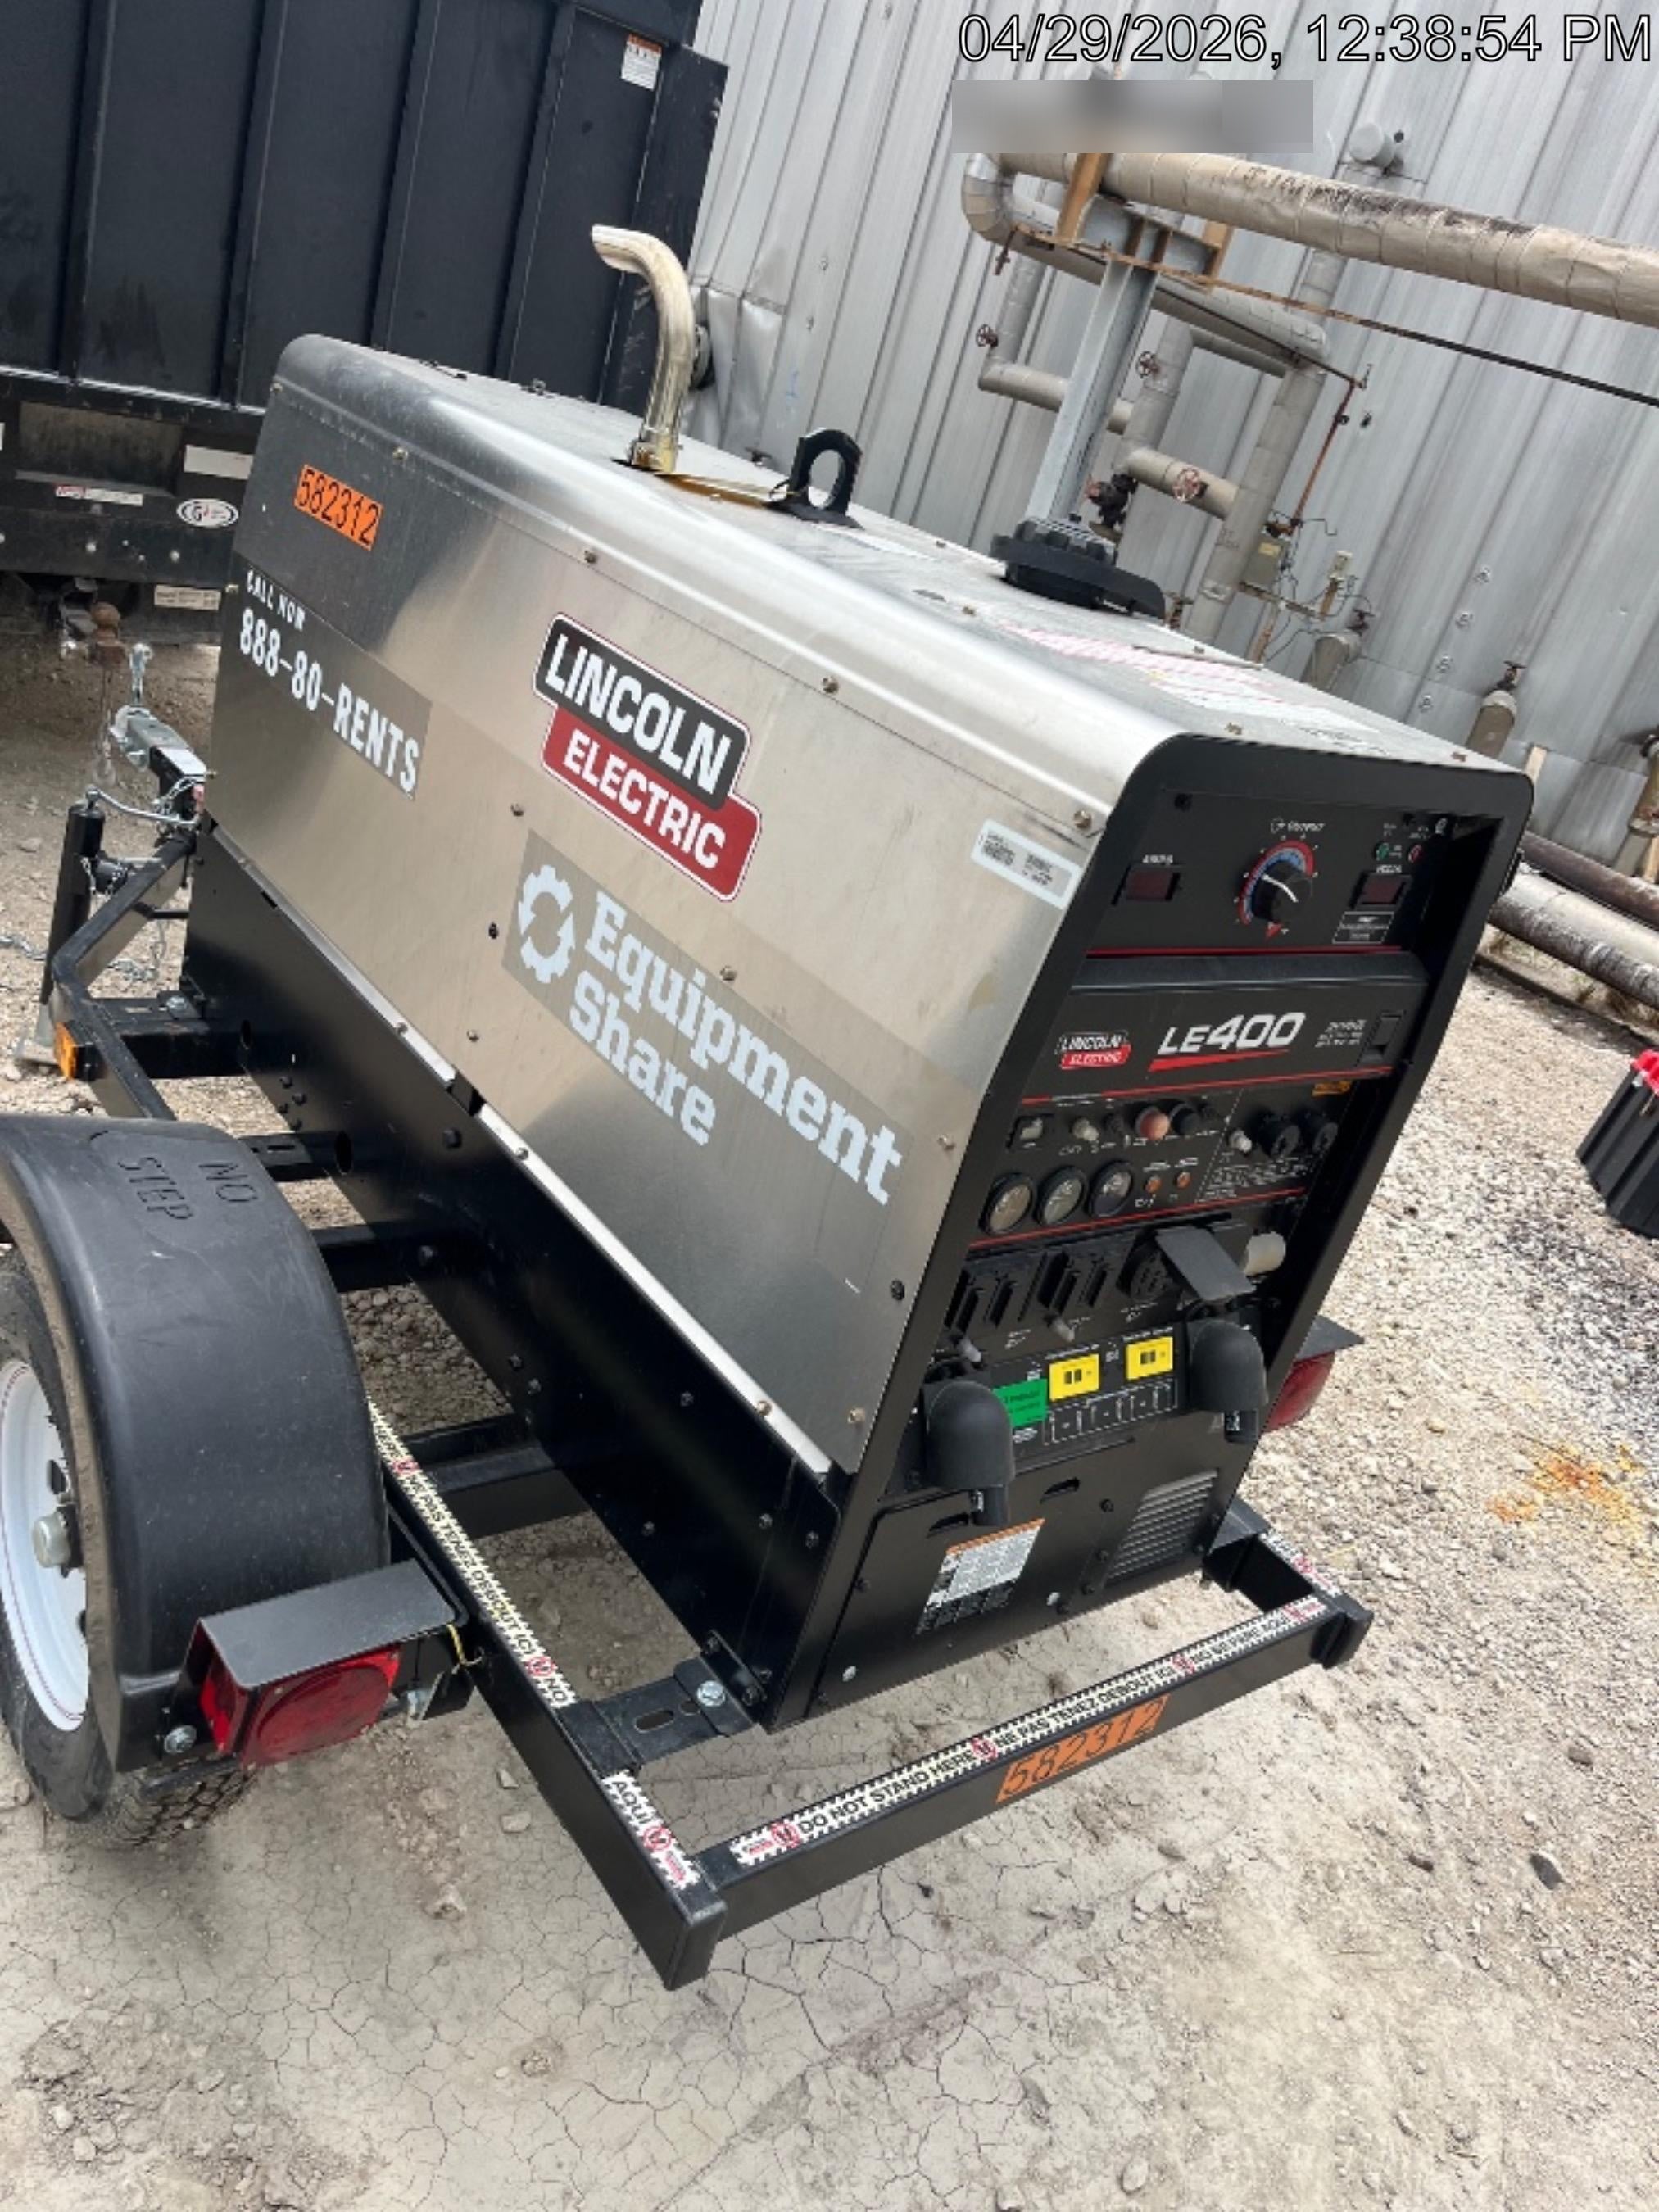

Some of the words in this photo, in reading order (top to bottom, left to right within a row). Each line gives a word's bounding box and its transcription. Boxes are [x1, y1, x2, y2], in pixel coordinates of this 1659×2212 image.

[297, 468, 380, 546] 582312
[247, 570, 274, 610] CALL
[277, 593, 306, 632] NOW
[239, 608, 419, 793] 888-80-RENTS
[544, 632, 733, 796] LINCOLN
[563, 728, 726, 870] ELECTRIC
[569, 970, 716, 1147] Share
[584, 890, 903, 1207] Equipment
[1061, 1034, 1122, 1051] LINCOLN
[1069, 1051, 1122, 1065] ELECTRIC
[1158, 1012, 1306, 1054] LE400
[117, 1156, 194, 1220] STEP
[198, 1161, 258, 1203] NO
[547, 1679, 569, 1702] NO
[798, 1813, 828, 1834] DO
[830, 1796, 868, 1820] NOT
[869, 1770, 930, 1802] STAND
[929, 1749, 976, 1776] HERE
[1018, 1717, 1050, 1739] PAS
[1004, 1698, 1165, 1796] 582312
[611, 1780, 653, 1824] AQUI
